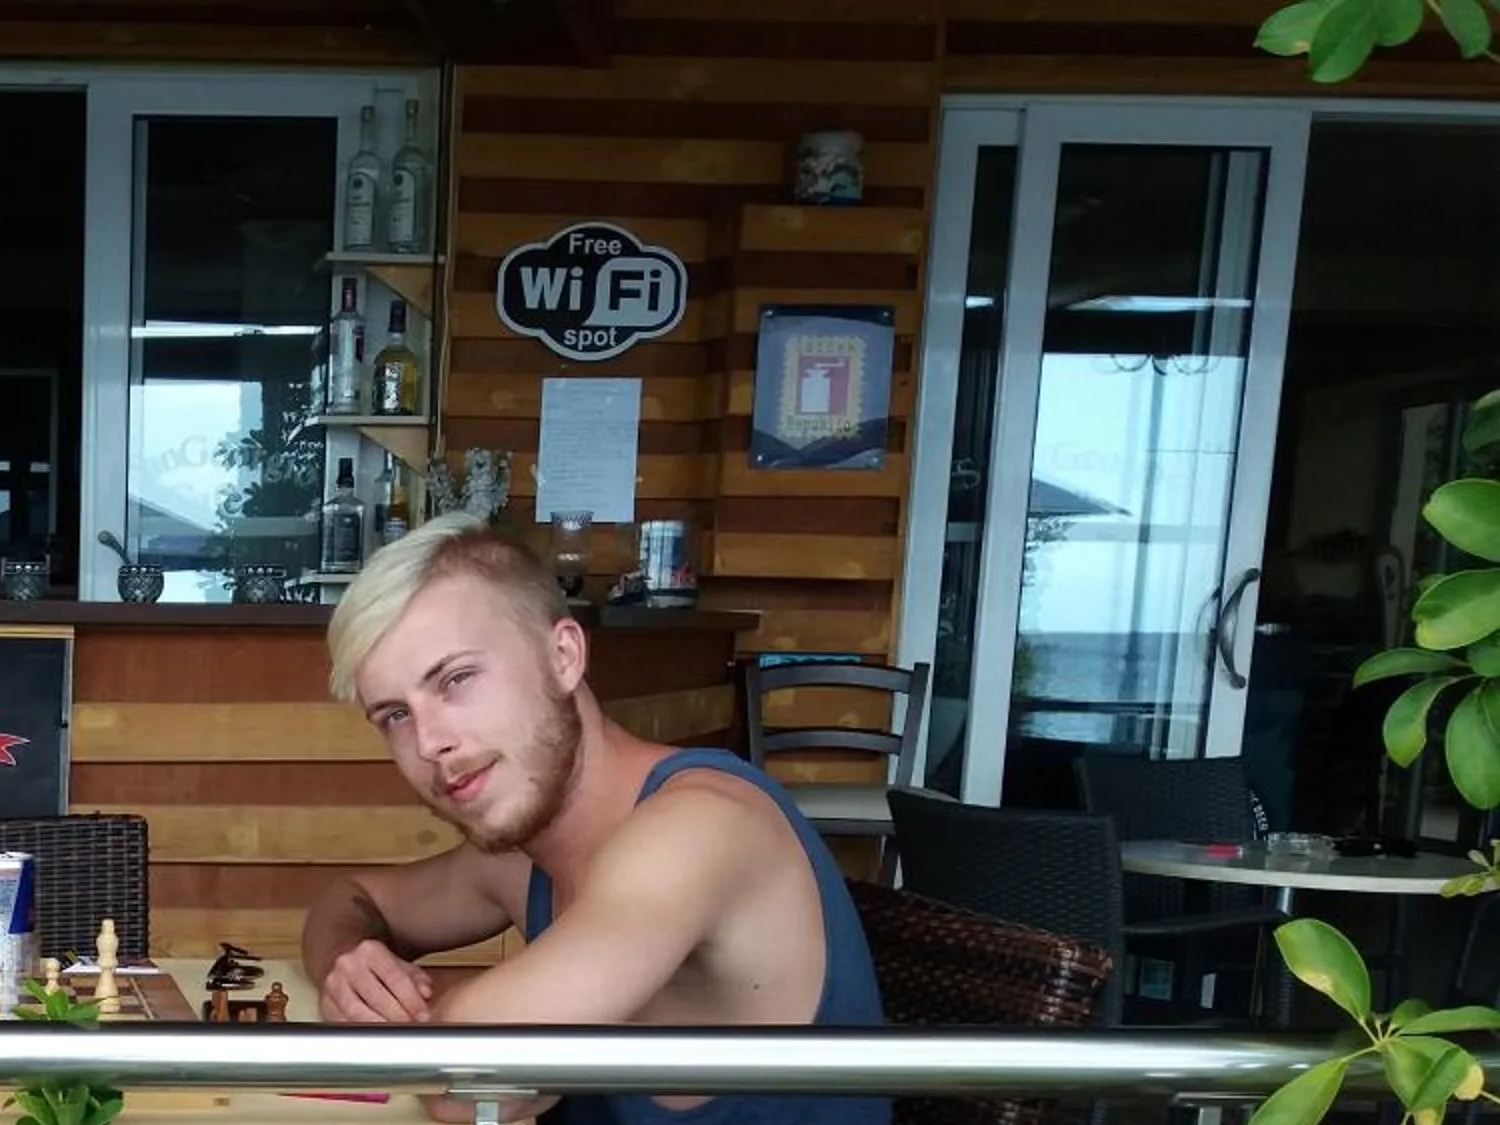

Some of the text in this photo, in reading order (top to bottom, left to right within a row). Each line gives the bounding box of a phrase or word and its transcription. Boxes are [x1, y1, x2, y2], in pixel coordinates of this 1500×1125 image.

[568, 233, 623, 255] Free
[519, 265, 664, 312] Wi Fi
[563, 327, 618, 351] spot
